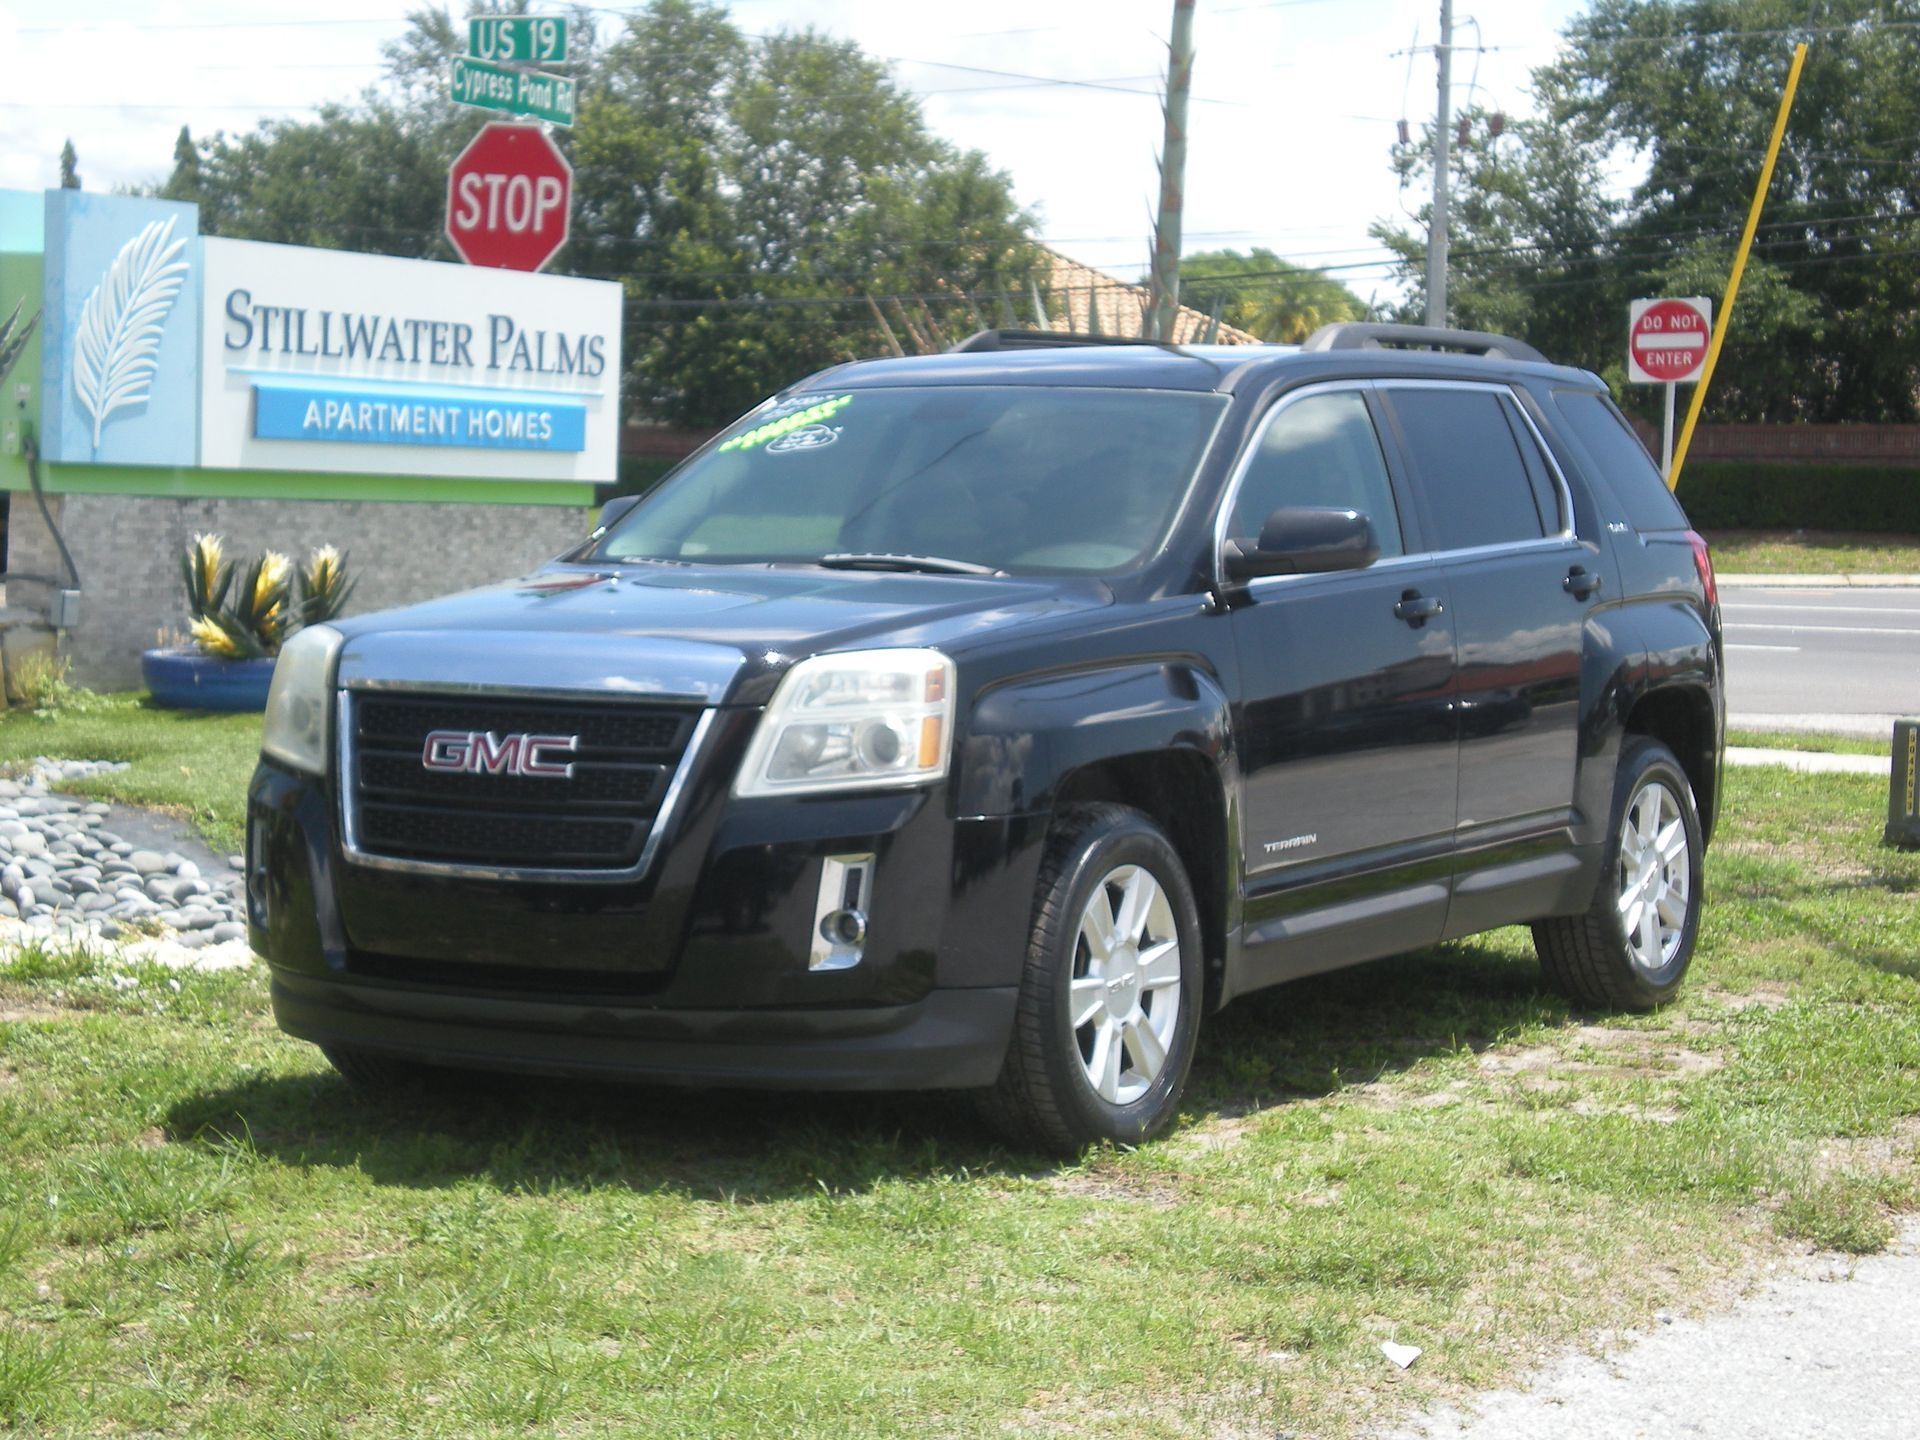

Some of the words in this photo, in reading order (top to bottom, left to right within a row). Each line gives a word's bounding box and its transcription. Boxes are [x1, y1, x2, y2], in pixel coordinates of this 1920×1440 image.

[478, 20, 515, 59] US
[529, 20, 557, 58] 19
[452, 60, 513, 100] Cypress
[518, 74, 551, 109] Pond
[557, 82, 572, 113] Rd
[456, 172, 562, 233] STOP
[1643, 315, 1663, 330] DO
[1671, 314, 1699, 329] NOT
[1647, 351, 1692, 366] ENTER
[303, 400, 461, 436] APARTMENT
[468, 410, 553, 440] HOMES
[423, 730, 578, 778] GMC
[1263, 833, 1317, 853] TERRAIN
